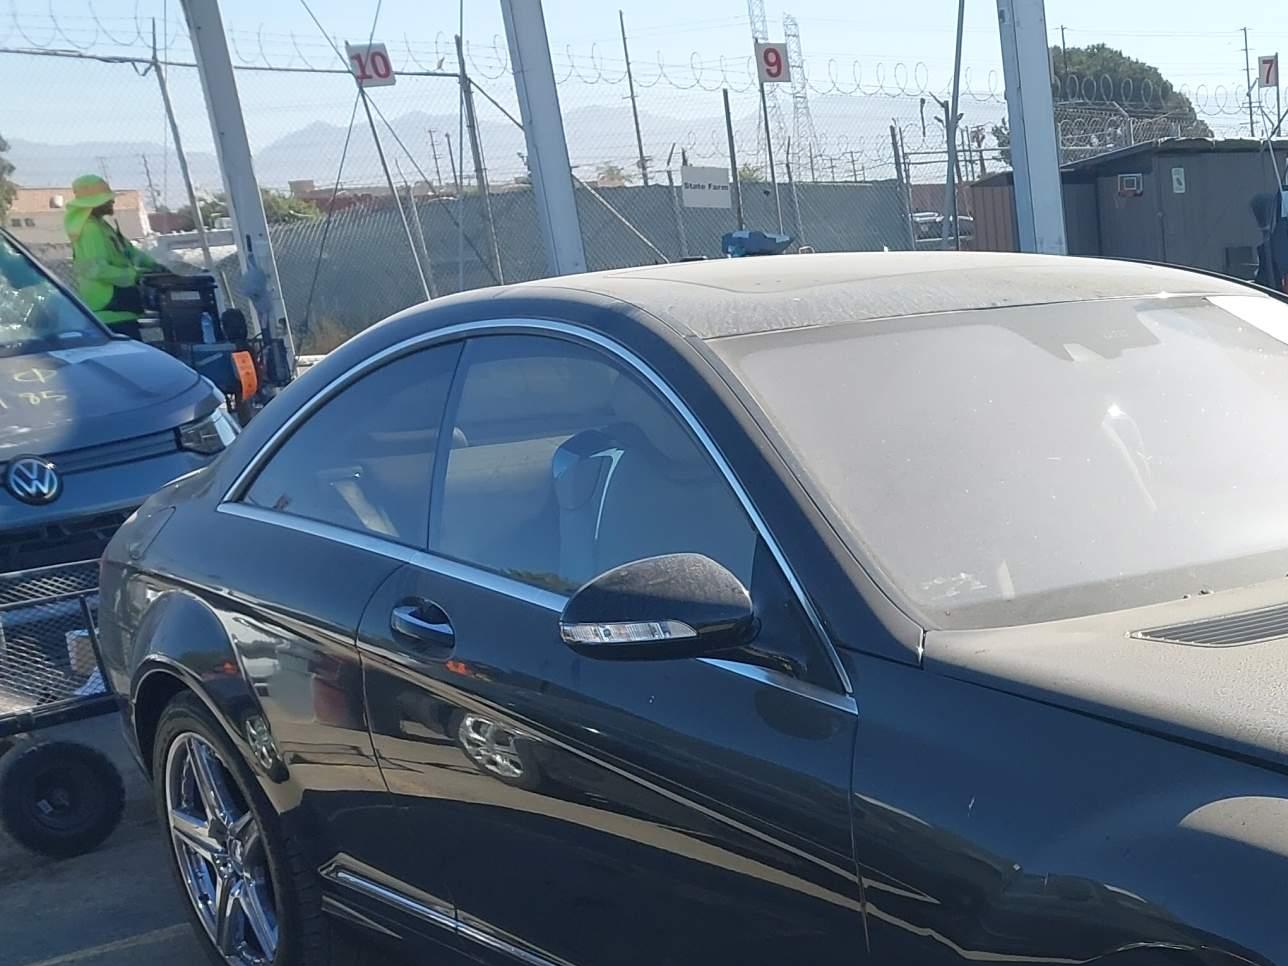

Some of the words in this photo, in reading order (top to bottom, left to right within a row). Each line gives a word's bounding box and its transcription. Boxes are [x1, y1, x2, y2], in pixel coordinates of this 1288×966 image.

[351, 51, 391, 80] 10
[763, 47, 783, 78] 9
[1262, 59, 1274, 85] 7
[683, 182, 706, 190] State
[708, 183, 729, 191] Farm
